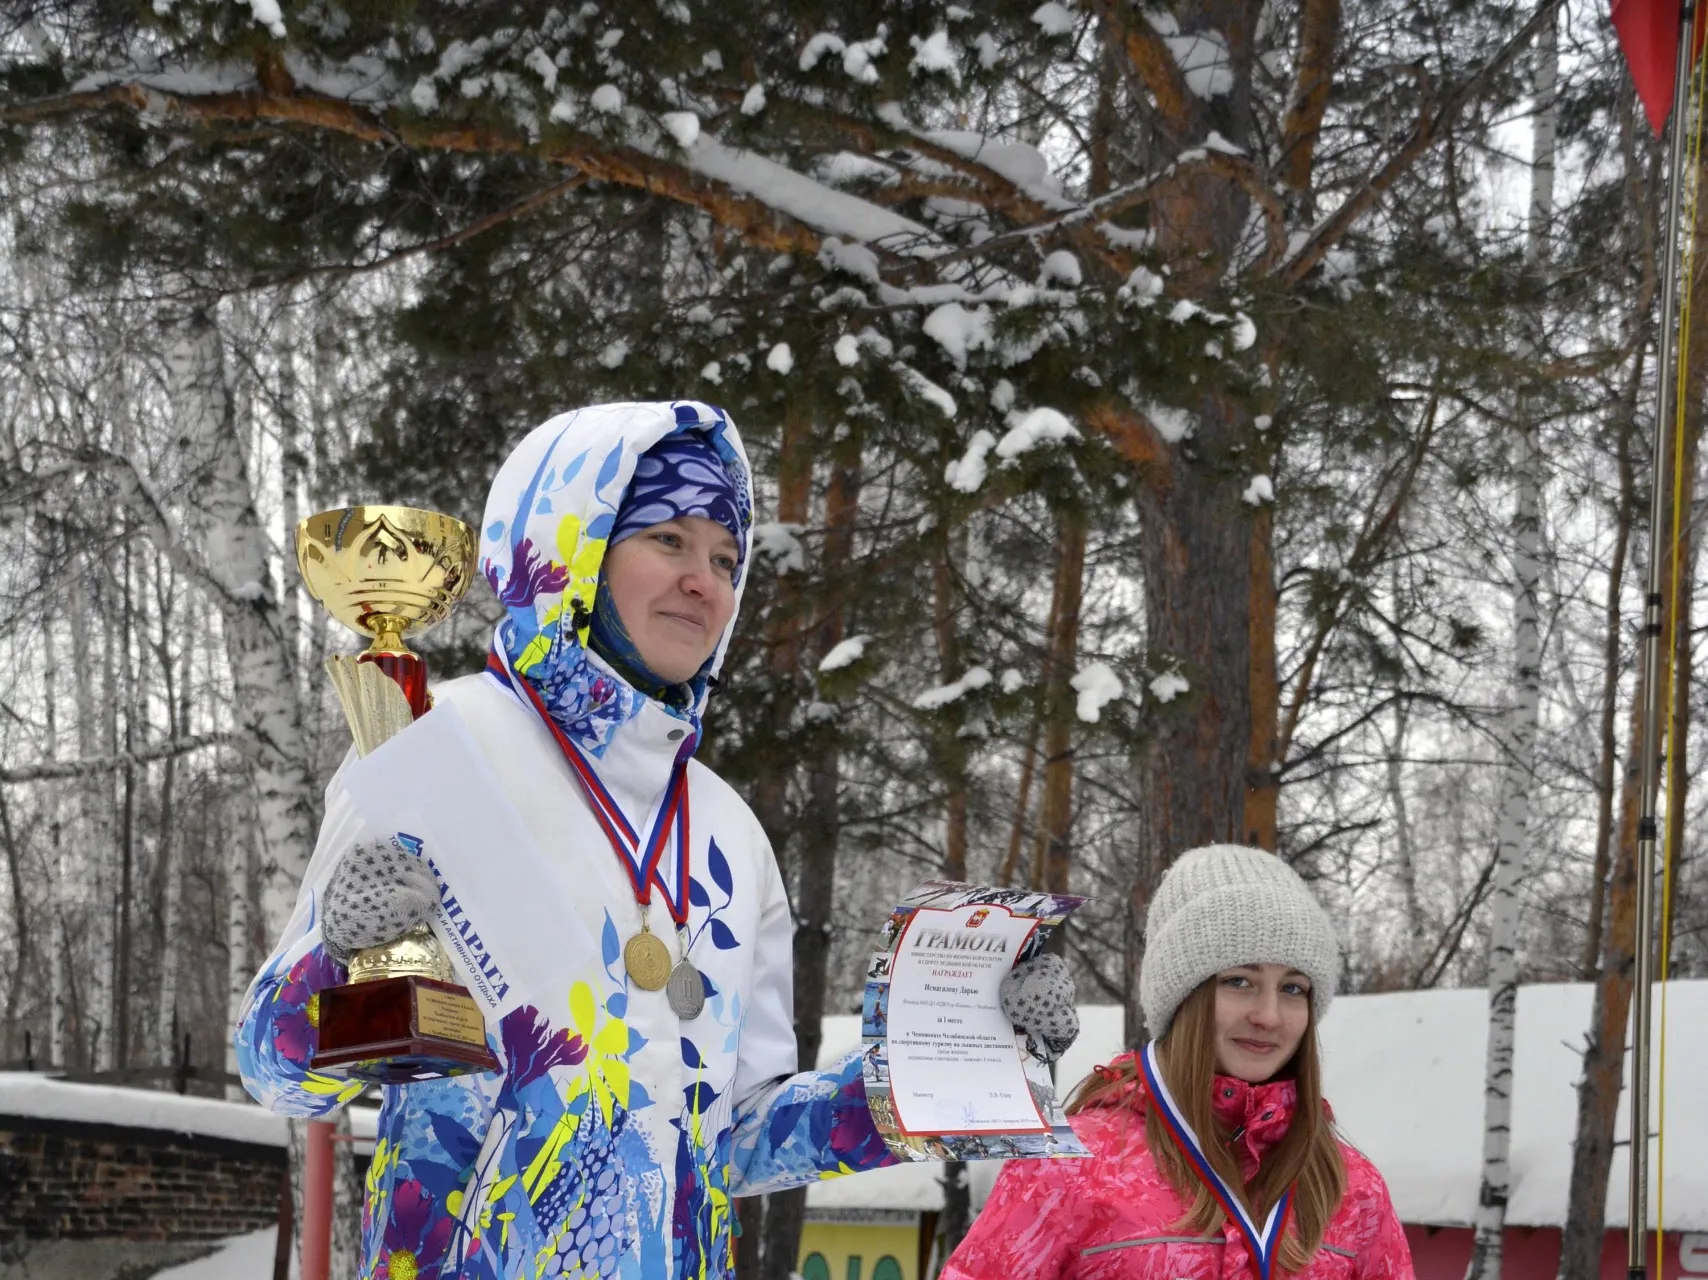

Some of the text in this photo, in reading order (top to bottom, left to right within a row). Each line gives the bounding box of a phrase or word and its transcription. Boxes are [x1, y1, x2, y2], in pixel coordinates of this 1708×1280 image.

[913, 929, 1007, 953] ГРАМОТА
[445, 927, 476, 974] АКТИВНОГО
[474, 975, 497, 1008] ОТДЫХА
[931, 968, 973, 979] НАГРАЖДАЕТ
[959, 986, 979, 996] Дарью
[911, 1030, 942, 1039] Чемпионате
[942, 1032, 976, 1041] Челябинской
[898, 1040, 931, 1048] спортивному
[932, 1041, 953, 1049] туризму
